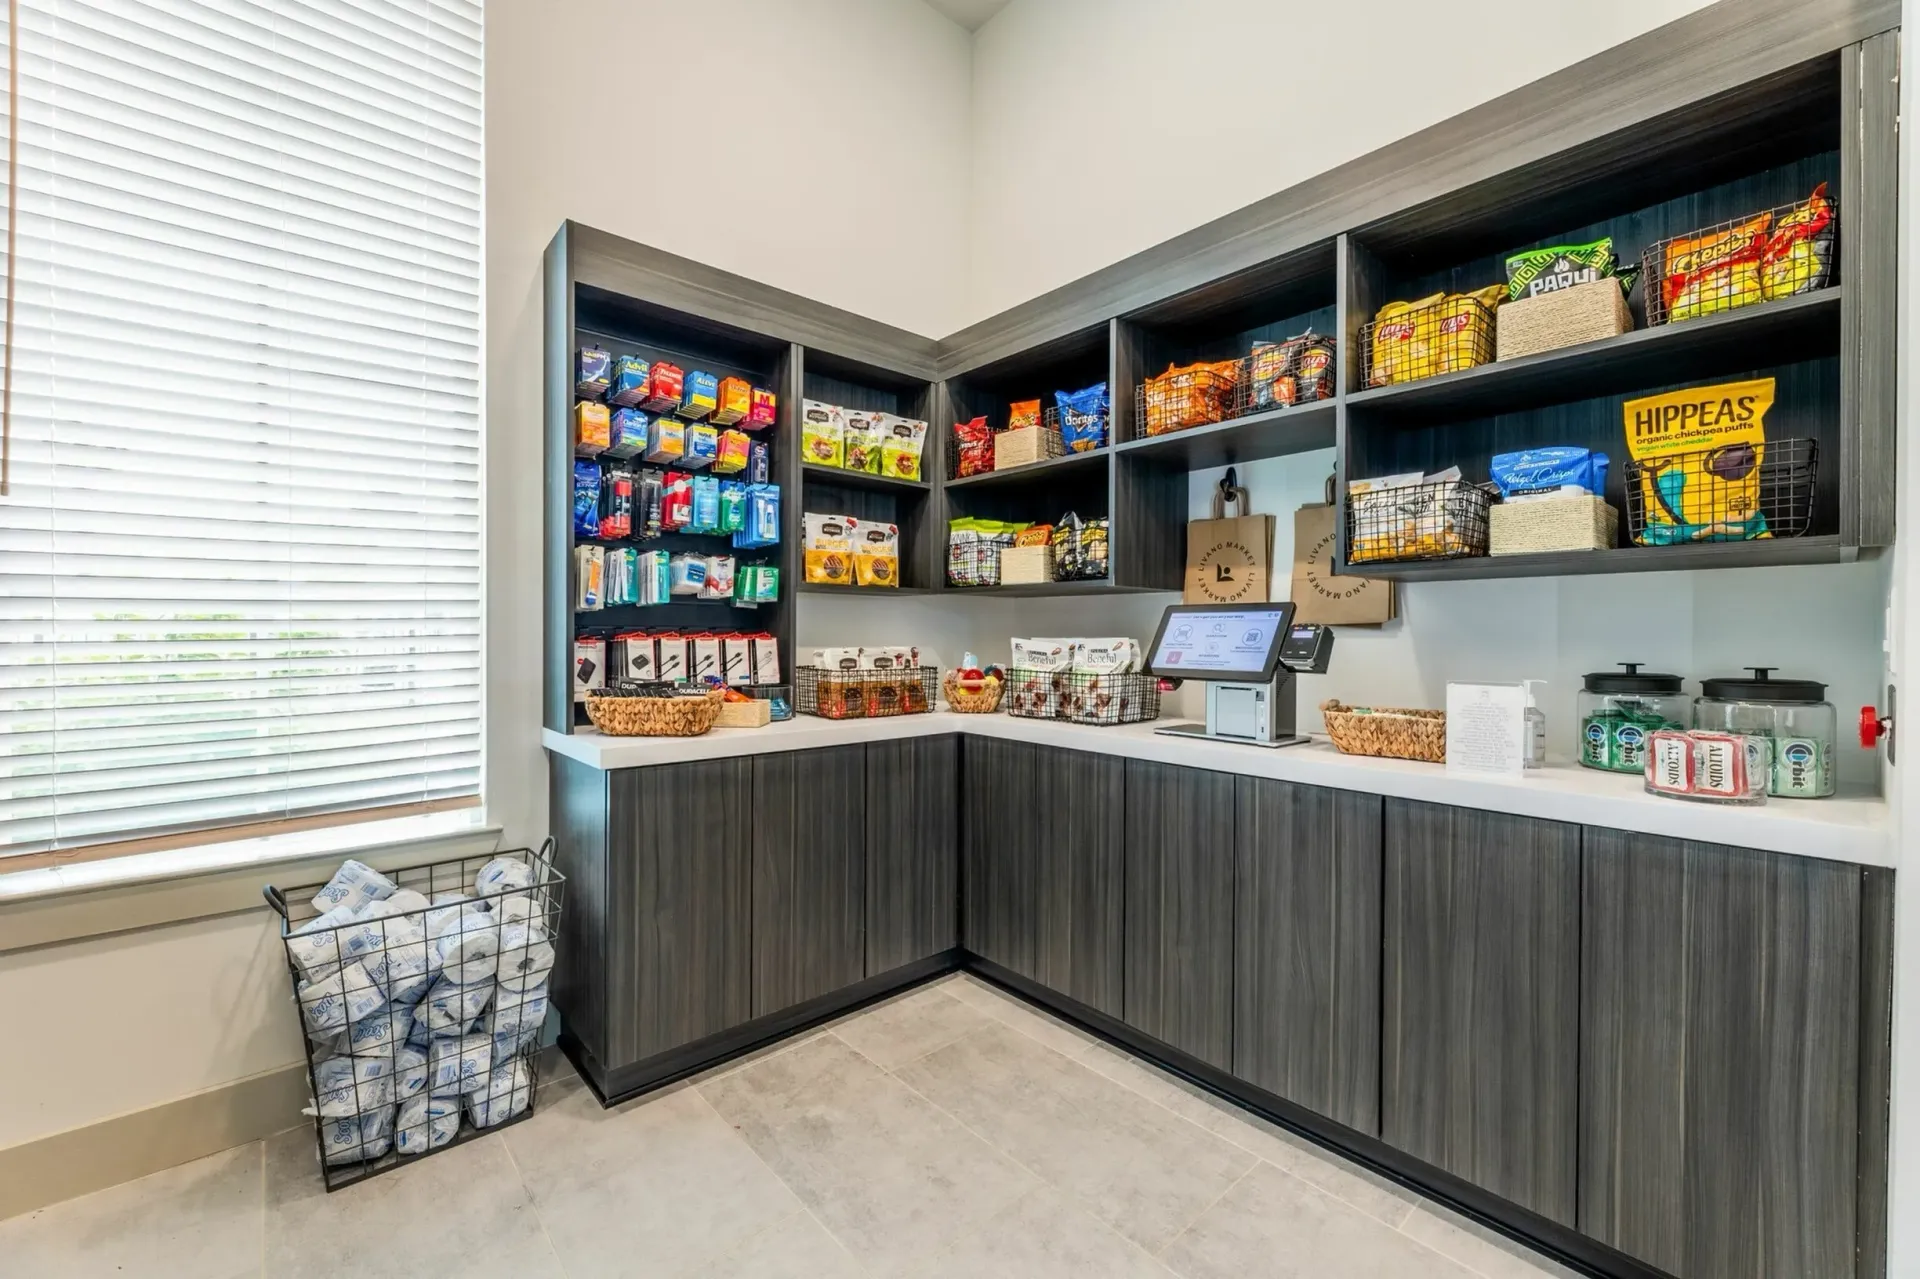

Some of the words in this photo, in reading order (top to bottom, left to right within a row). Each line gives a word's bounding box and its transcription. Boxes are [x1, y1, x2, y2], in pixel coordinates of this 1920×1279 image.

[625, 360, 648, 373] Advil
[1065, 414, 1099, 426] Doritos
[1635, 396, 1756, 437] HIPPEAS
[1636, 434, 1673, 445] organic
[1674, 426, 1723, 439] chickpea
[1724, 421, 1754, 433] puffs
[1636, 444, 1660, 452] vegan
[1660, 440, 1680, 449] white
[1680, 436, 1713, 446] cheddar
[1198, 543, 1223, 572] LIVANO
[1226, 541, 1256, 567] MARKET
[1307, 533, 1336, 565] LIVANO
[1198, 577, 1227, 602] MARKET
[1230, 572, 1255, 602] LIVANO
[1307, 571, 1341, 600] MARKET
[1028, 653, 1056, 665] Beneful
[1667, 742, 1680, 785] ALTOIDS
[1708, 744, 1724, 788] ALTOIDS
